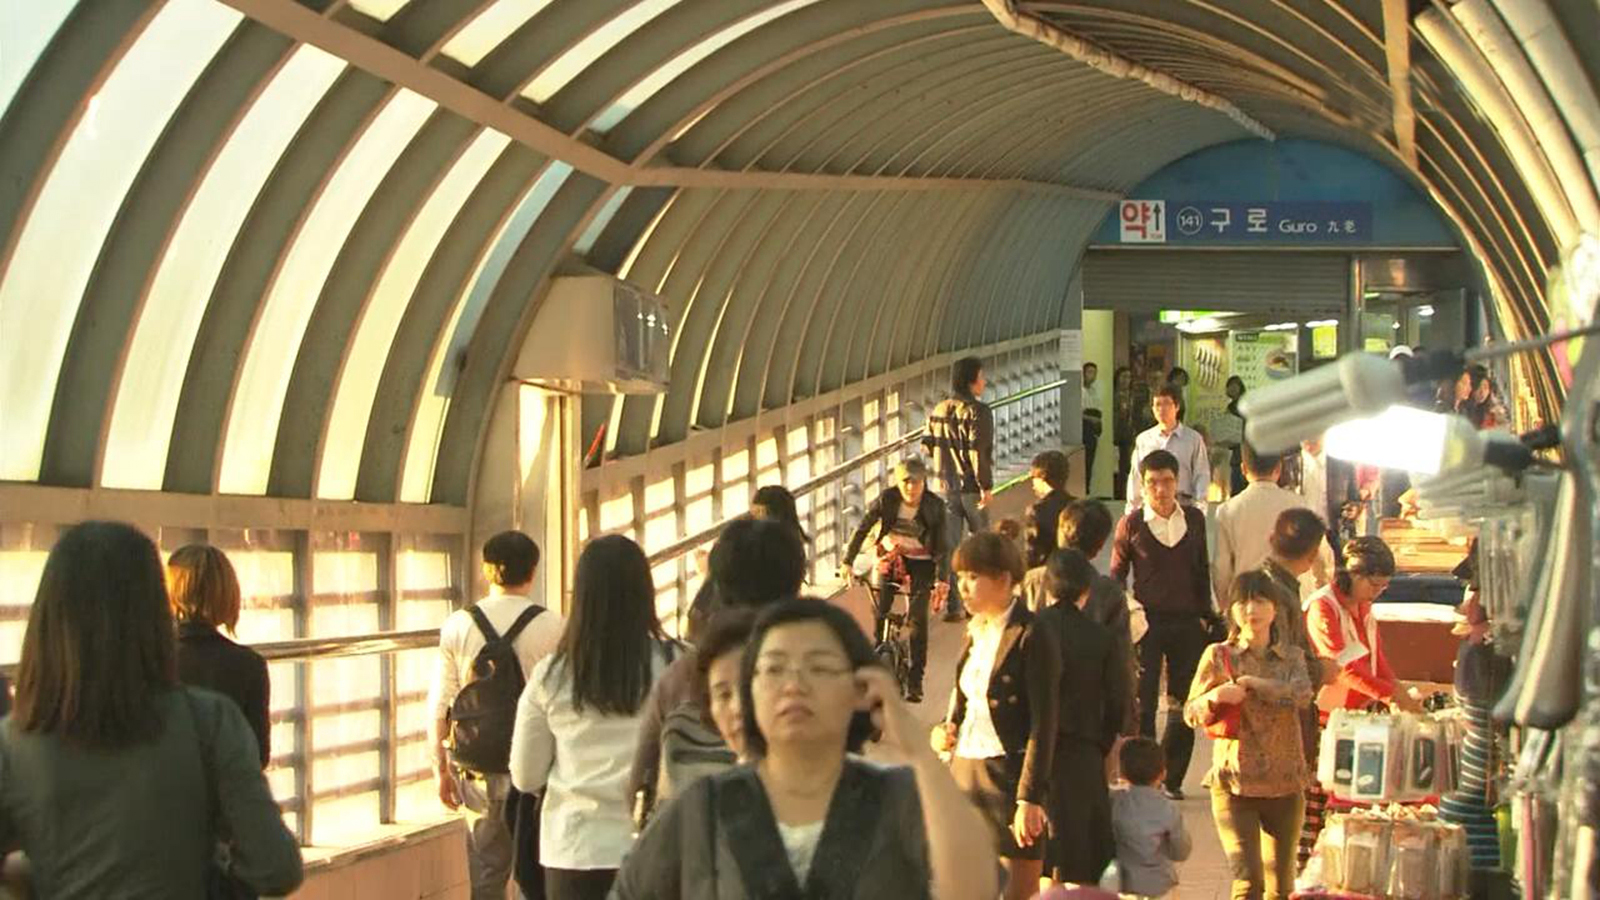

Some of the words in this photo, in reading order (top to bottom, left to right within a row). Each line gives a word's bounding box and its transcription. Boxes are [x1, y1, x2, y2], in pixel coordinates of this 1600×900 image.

[1122, 202, 1151, 239] 약
[1180, 215, 1200, 227] 141
[1279, 219, 1318, 233] Guro
